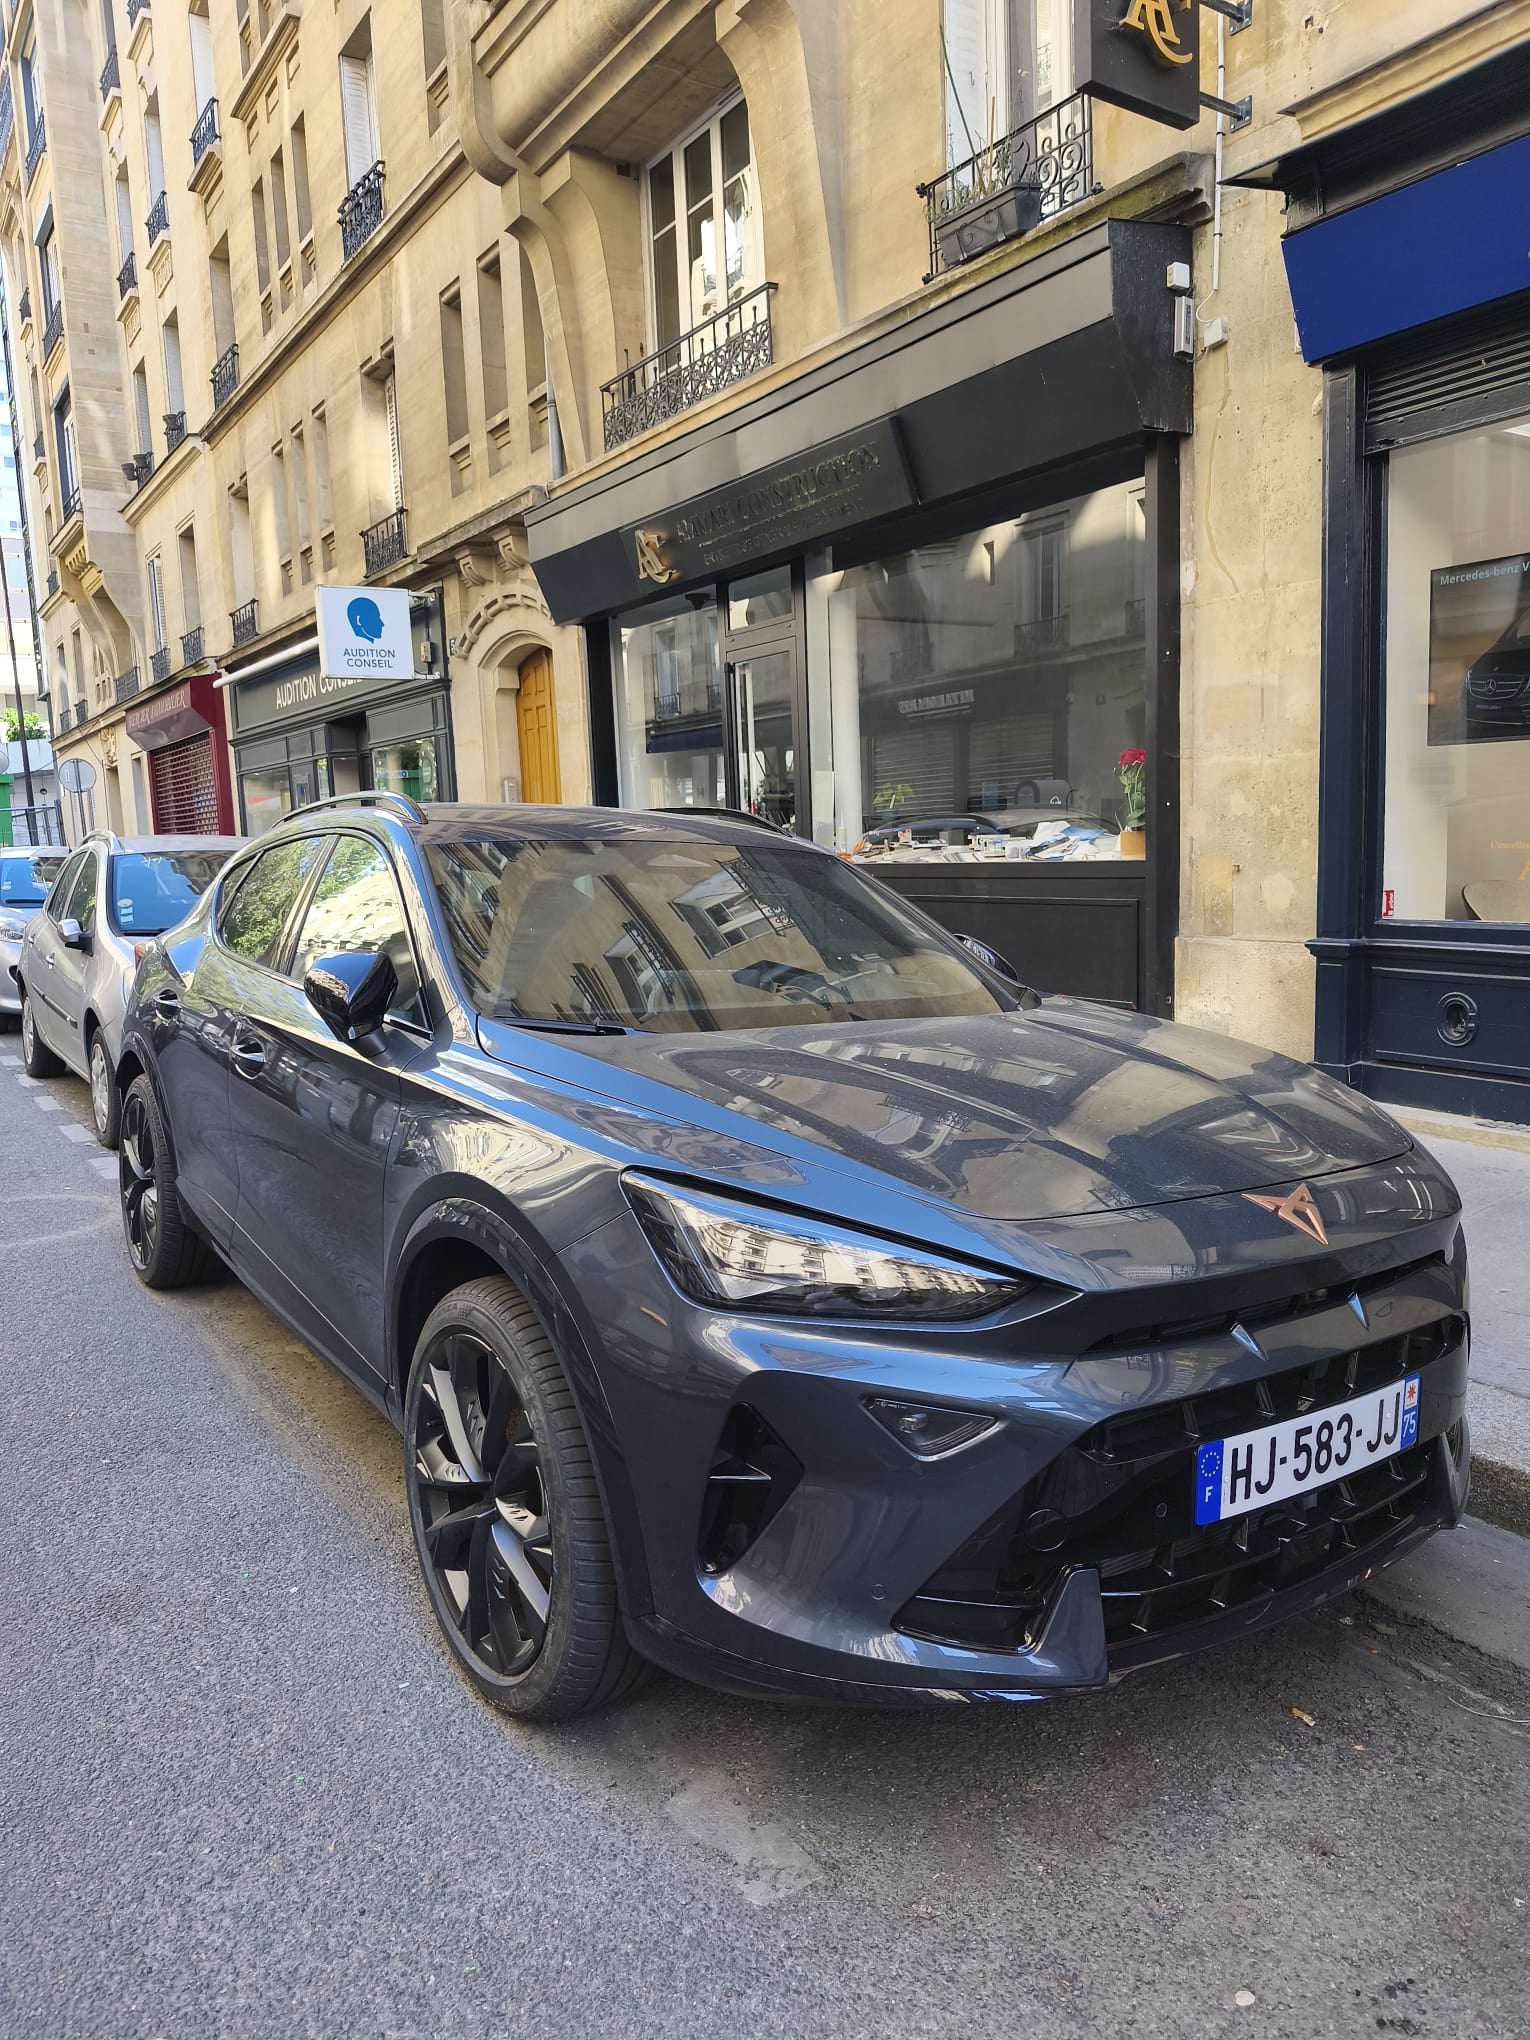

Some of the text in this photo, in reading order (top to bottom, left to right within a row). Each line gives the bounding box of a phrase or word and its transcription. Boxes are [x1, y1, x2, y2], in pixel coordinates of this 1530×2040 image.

[1440, 564, 1520, 586] Mercedes-benz
[343, 647, 396, 658] AUDITION
[346, 658, 393, 669] CONSEIL
[276, 673, 317, 710] AUDITION
[1205, 1391, 1416, 1505] F HJ-583-JJ 75
